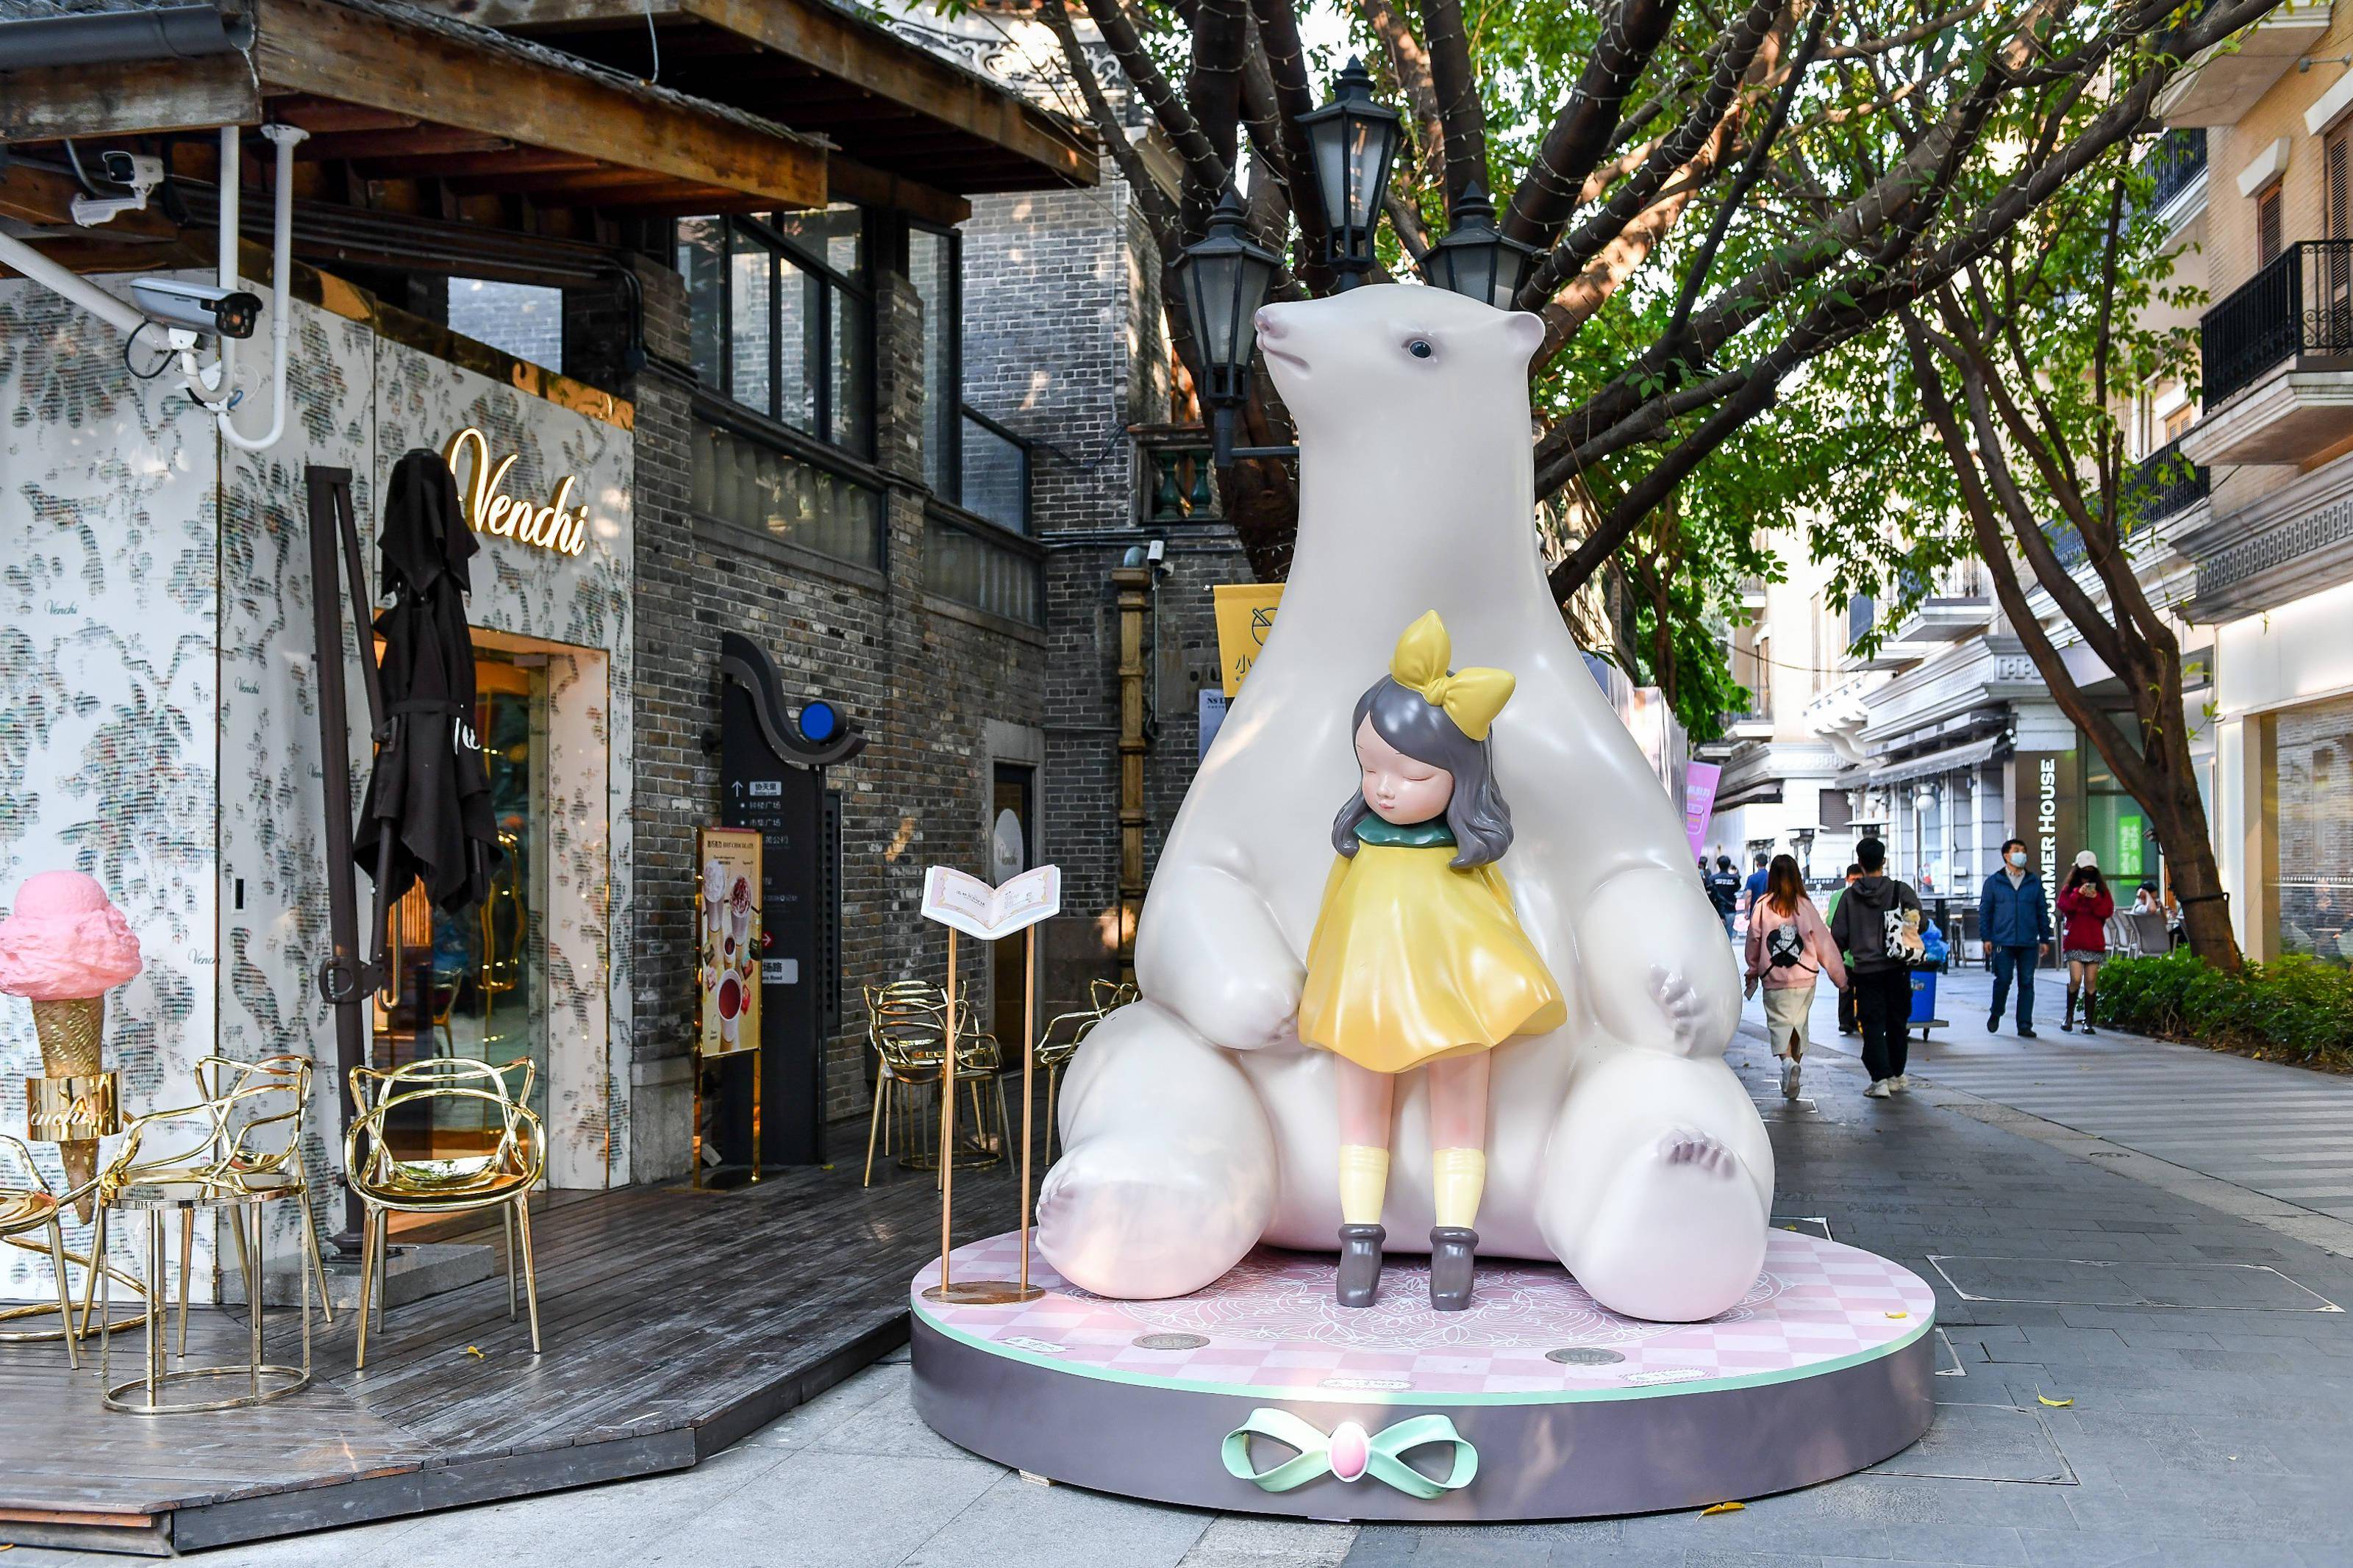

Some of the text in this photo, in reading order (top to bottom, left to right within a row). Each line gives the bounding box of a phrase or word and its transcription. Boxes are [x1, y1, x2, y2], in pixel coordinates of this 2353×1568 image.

[449, 428, 588, 556] Venchi
[43, 599, 79, 615] Venchi
[235, 676, 260, 694] Venchi
[2038, 758, 2057, 928] SUMMER HOUSE
